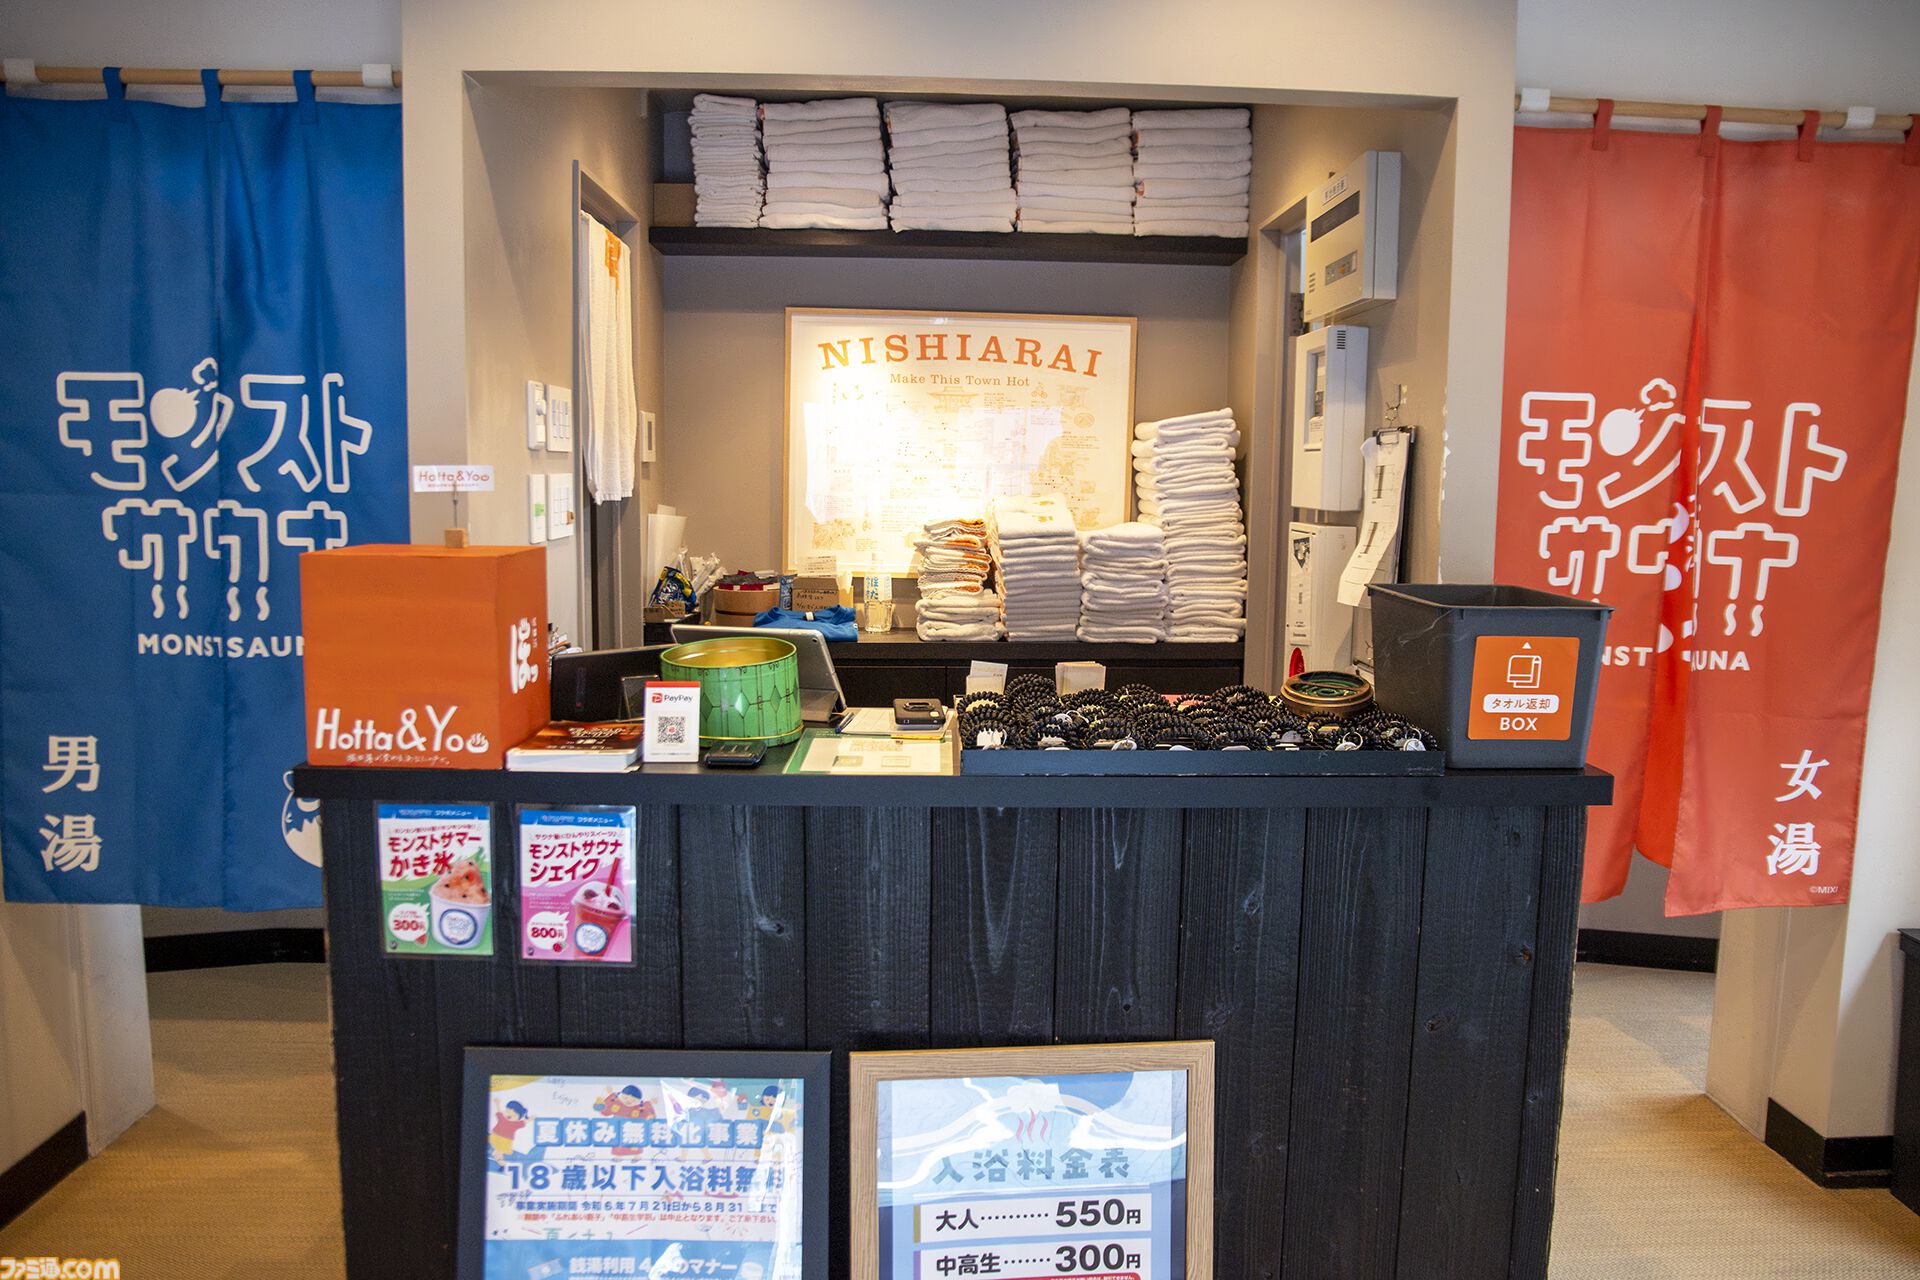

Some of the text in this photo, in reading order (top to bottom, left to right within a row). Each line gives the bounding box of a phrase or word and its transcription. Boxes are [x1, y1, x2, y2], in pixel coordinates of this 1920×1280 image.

[817, 333, 1102, 378] NISHIARAI
[890, 373, 1030, 387] Make This Town Hot
[663, 693, 694, 703] PayPay
[1491, 698, 1550, 710] タオル返却
[1499, 717, 1538, 731] BOX
[39, 735, 103, 873] 男湯
[1766, 749, 1830, 875] 女湯
[387, 831, 482, 853] モンストサマー
[529, 839, 623, 860] モンストサウナ
[388, 851, 455, 878] かき氷
[530, 858, 601, 882] シェイク
[535, 1119, 761, 1147] 夏休み無料化事業
[932, 1147, 1130, 1185] 入浴料金表
[936, 1208, 979, 1232] 大人
[936, 1252, 1002, 1277] 中高生
